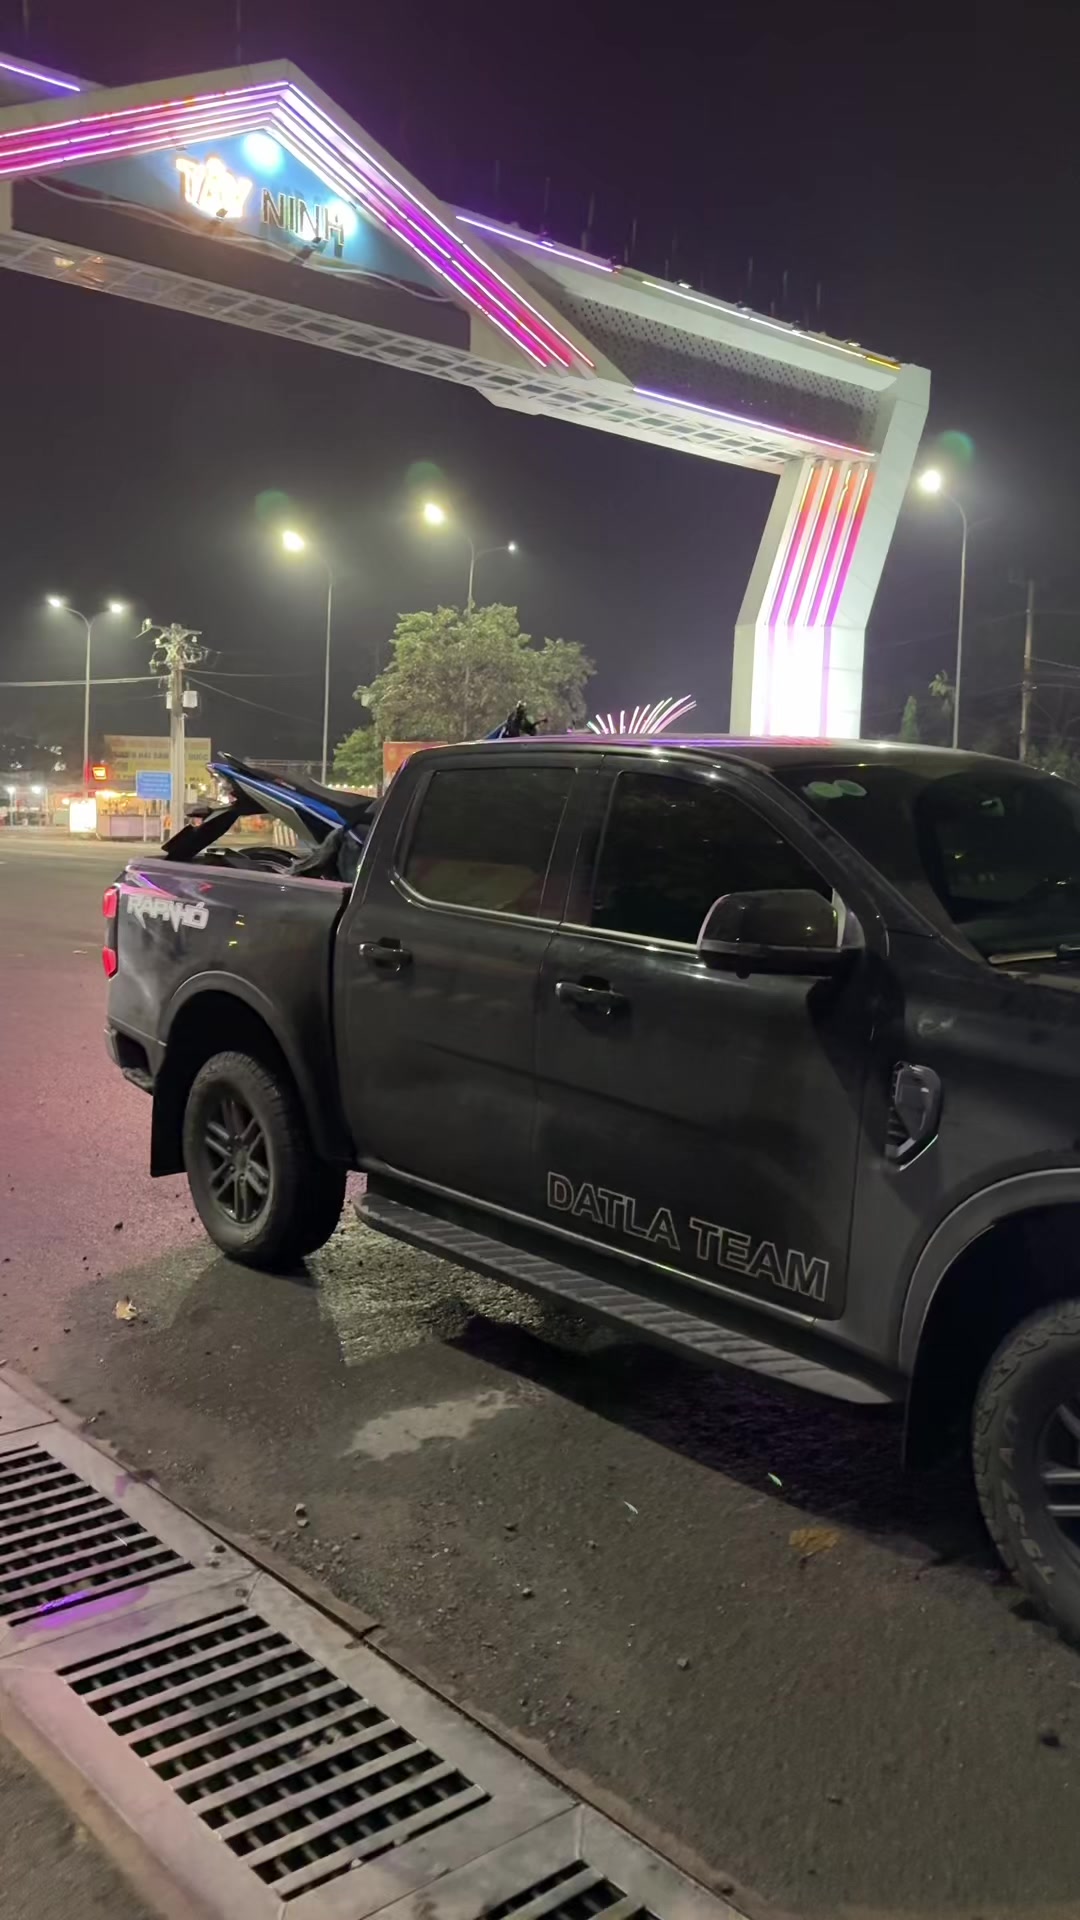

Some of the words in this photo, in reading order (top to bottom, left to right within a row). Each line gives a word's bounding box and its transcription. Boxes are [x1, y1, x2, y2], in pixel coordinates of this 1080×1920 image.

[261, 187, 345, 246] NINH
[548, 1171, 680, 1251] DATLA
[689, 1217, 829, 1302] TEAM
